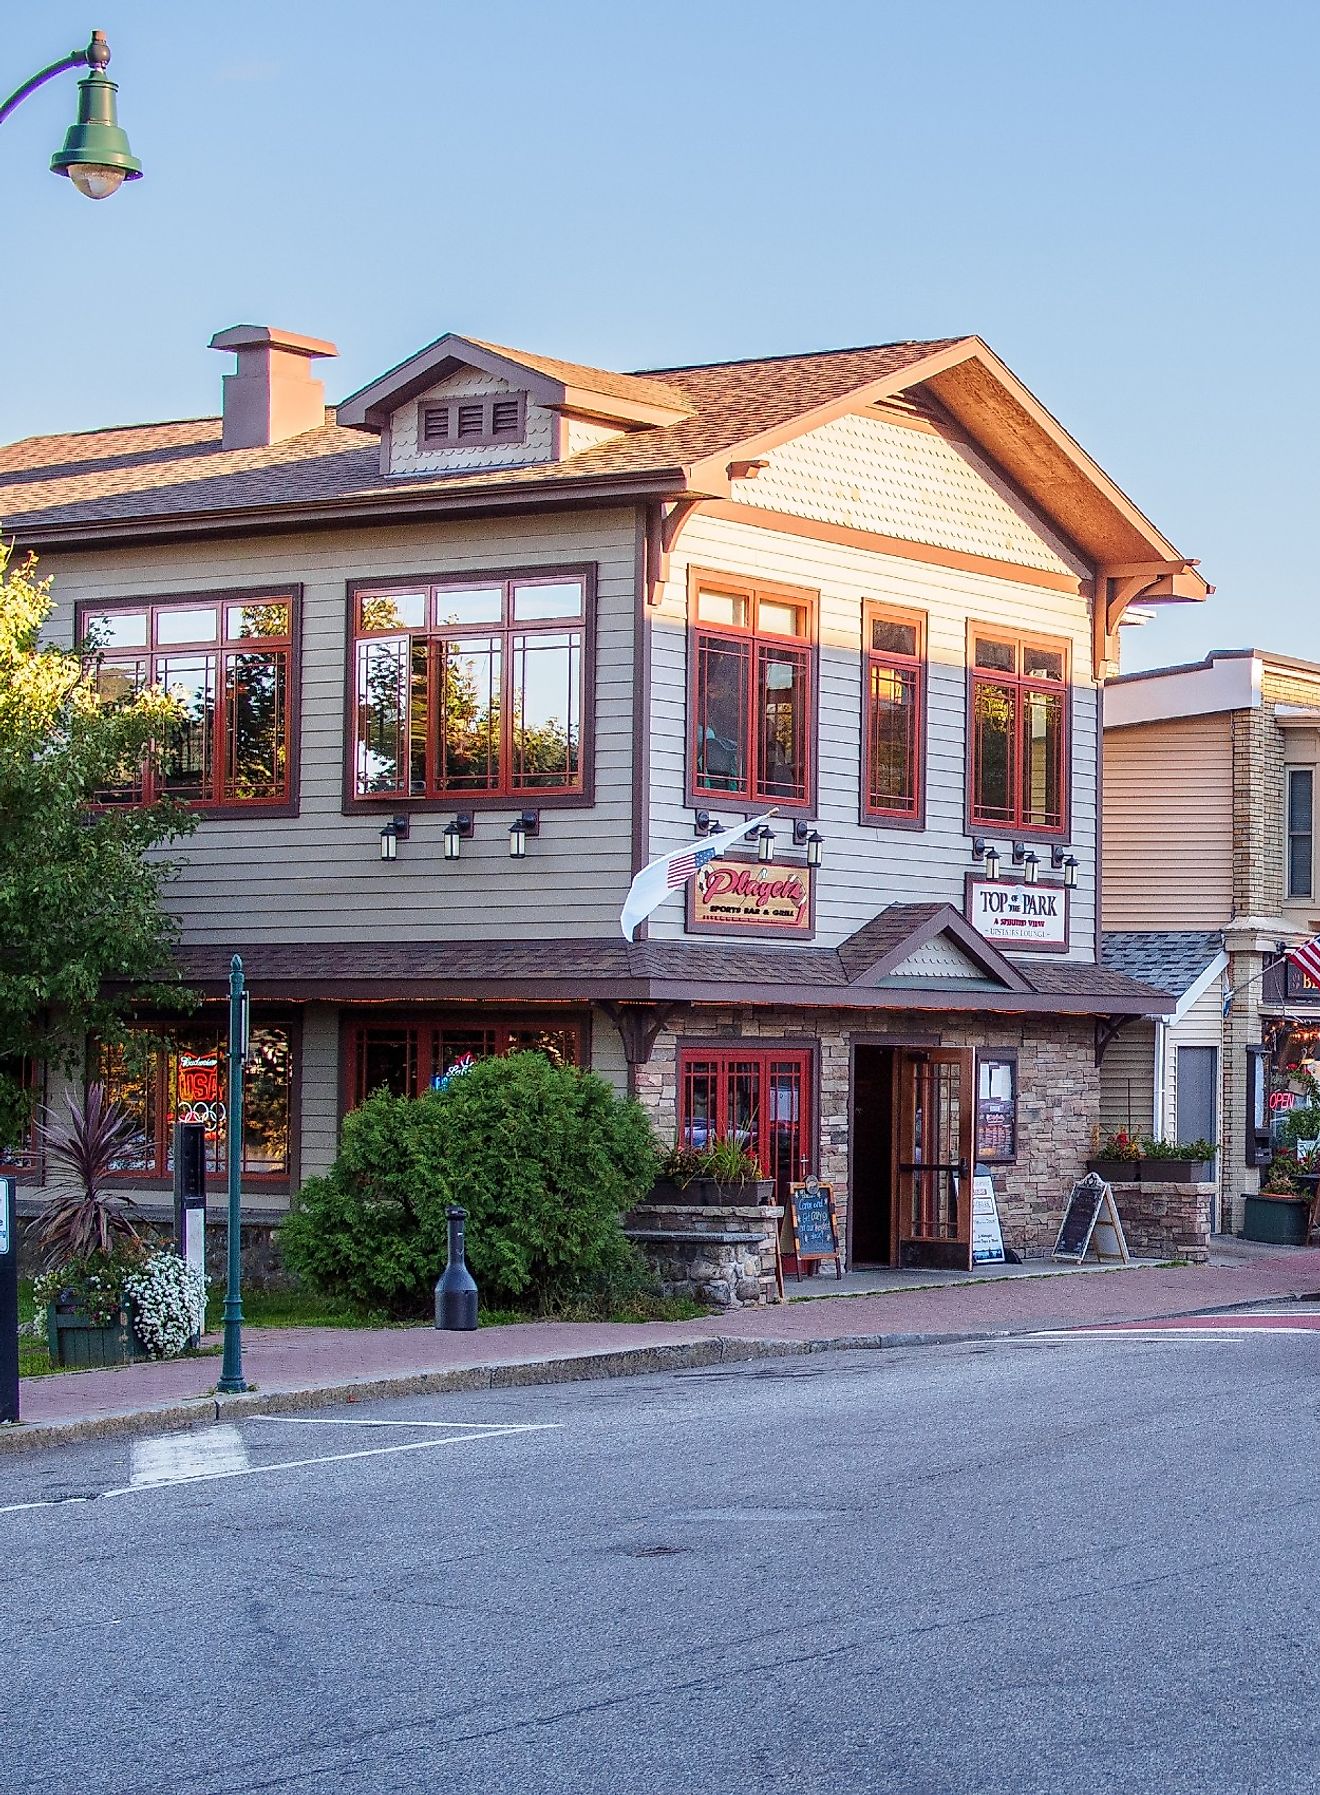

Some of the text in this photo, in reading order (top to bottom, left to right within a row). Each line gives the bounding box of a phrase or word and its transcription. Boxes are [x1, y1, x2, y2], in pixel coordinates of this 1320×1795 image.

[709, 905, 795, 917] SPORTS BAR & GRILL
[980, 891, 1058, 916] TOP OF THE PARK
[993, 917, 999, 925] A
[1028, 919, 1046, 928] VIEW
[991, 927, 1045, 938] UPSTAIRS LOUNGE
[180, 1073, 224, 1101] USA
[1269, 1092, 1294, 1110] OPEN
